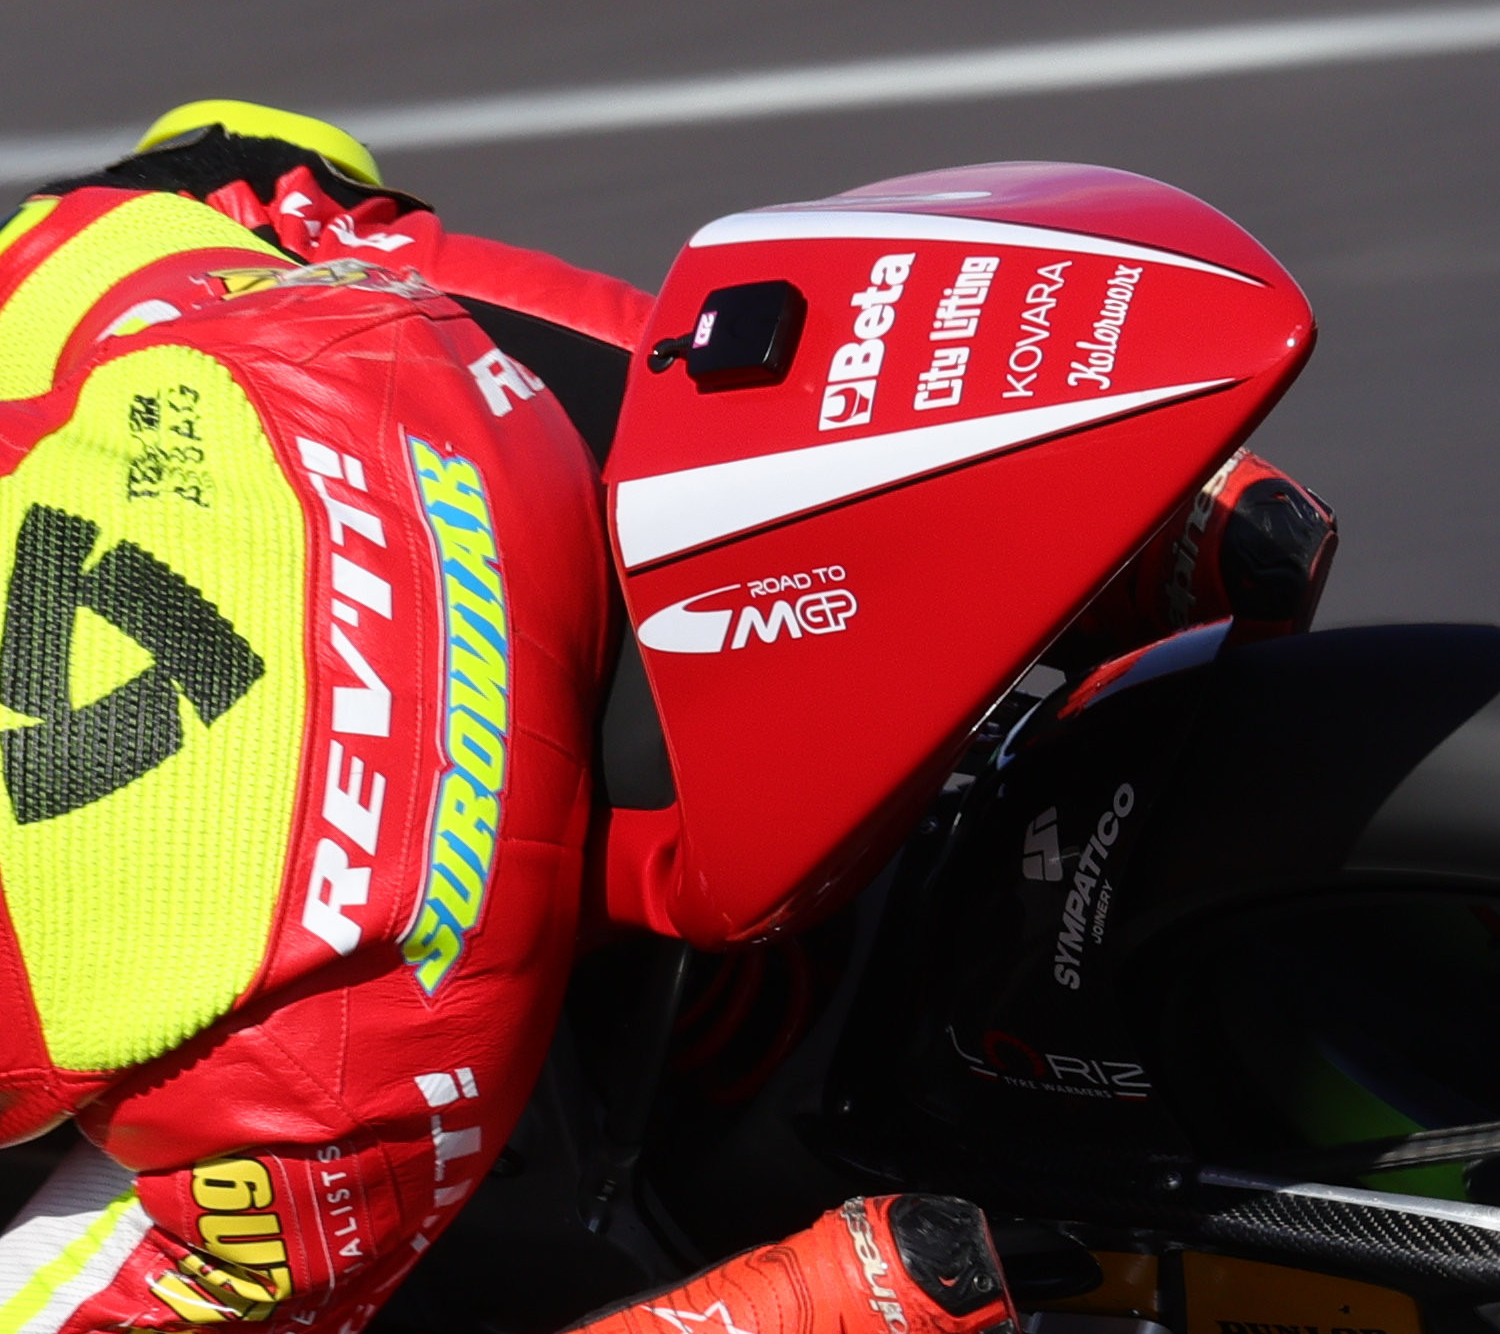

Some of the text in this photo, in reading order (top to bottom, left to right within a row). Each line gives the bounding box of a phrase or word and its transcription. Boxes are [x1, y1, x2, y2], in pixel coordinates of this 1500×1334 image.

[827, 253, 916, 382] Beta
[913, 257, 1000, 411] City Lifting
[1002, 261, 1072, 398] KOVARA
[1067, 264, 1143, 390] Kolorworx
[747, 565, 846, 598] ROAD TO
[297, 436, 393, 957] REV'IT!
[403, 434, 508, 995] SUROWIAK
[1054, 783, 1134, 990] SYMPATICO
[1091, 882, 1114, 944] JOINERY
[1004, 1076, 1113, 1099] TYRE WARMERS
